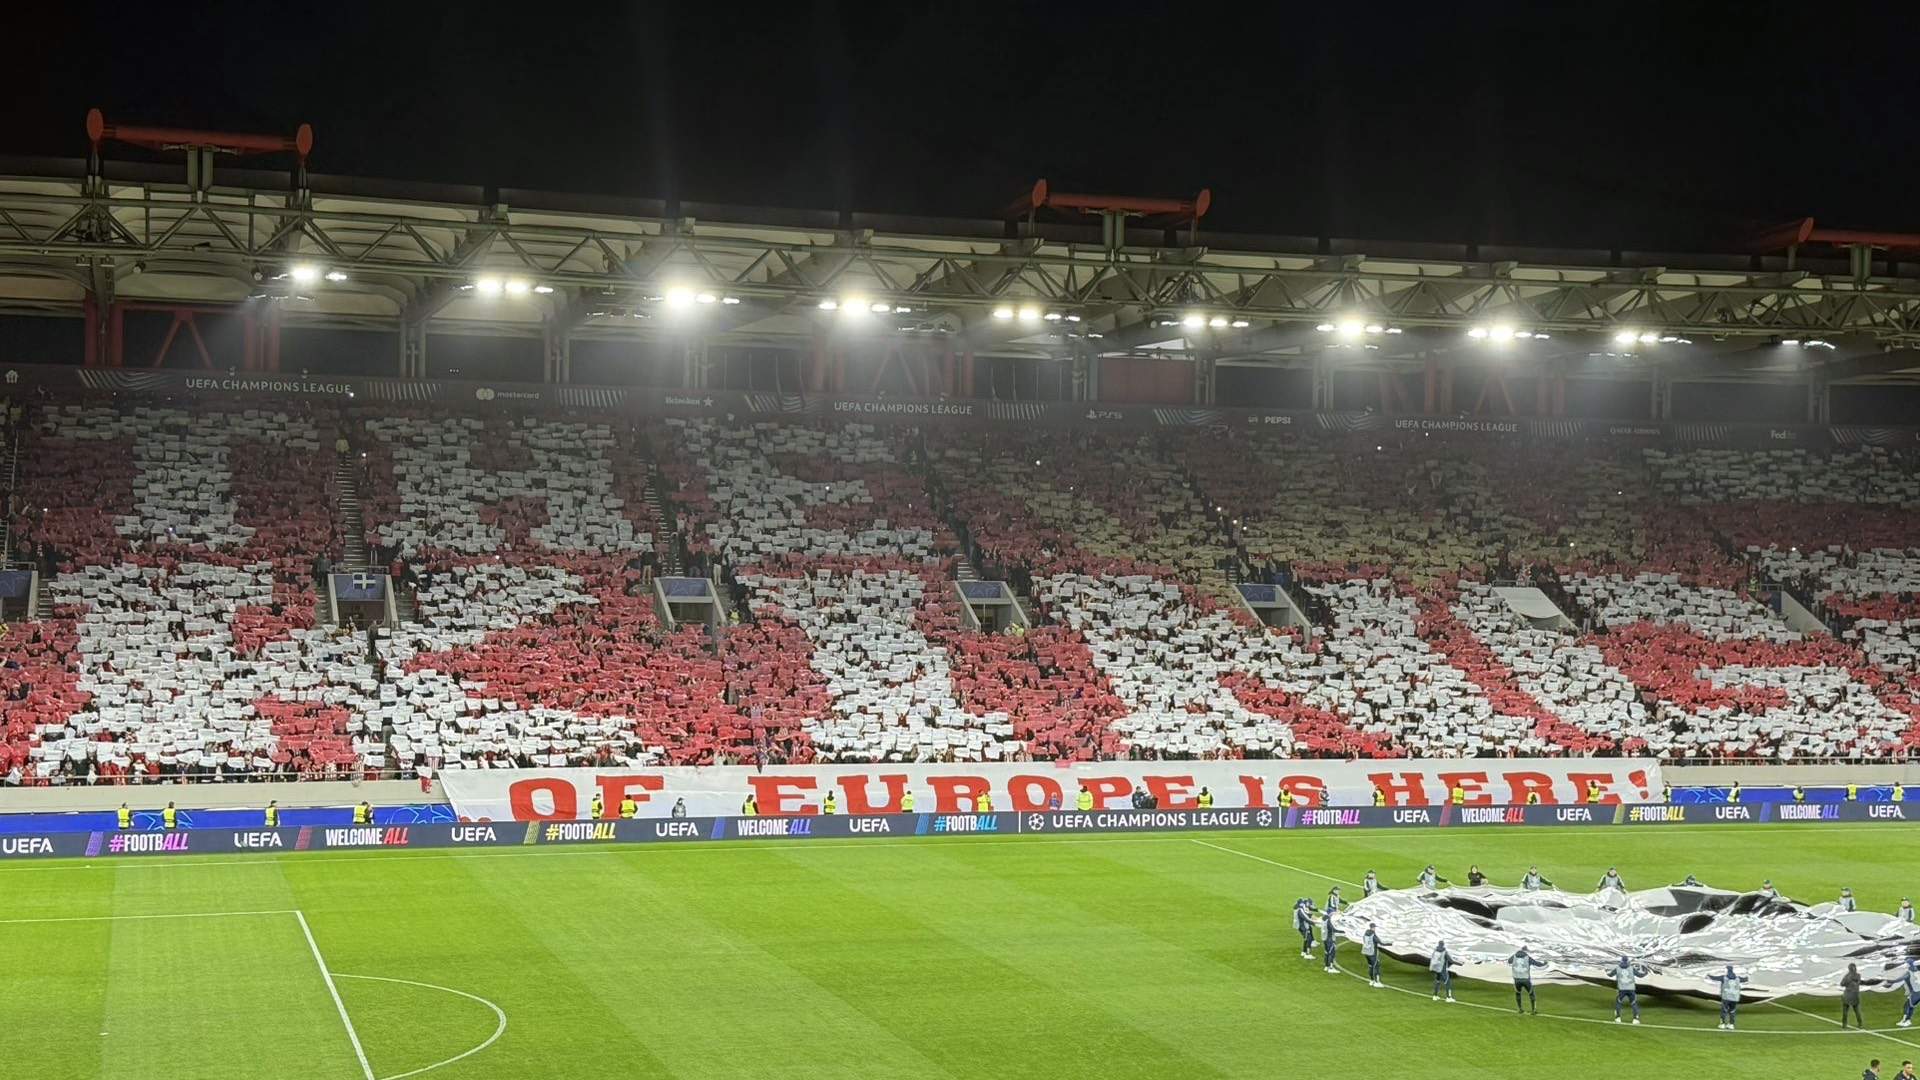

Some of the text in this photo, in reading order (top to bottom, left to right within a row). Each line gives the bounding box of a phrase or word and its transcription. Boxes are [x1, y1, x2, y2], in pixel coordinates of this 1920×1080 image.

[186, 378, 352, 394] UEFA CHAMPIONS LEAGUE
[834, 400, 973, 415] UEFA CHAMPIONS LEAGUE
[1264, 415, 1291, 424] PEPSI
[1395, 419, 1519, 432] UEFA CHAMPIONS LEAGUE
[509, 768, 1650, 823] OF EUROPE IS HERE!
[1301, 808, 1361, 825] #FOOTBALL
[1393, 809, 1430, 824] UEFA
[1461, 807, 1525, 823] WELCOME ALL
[1555, 808, 1593, 821] UEFA
[1629, 806, 1686, 821] #FOOTBALL
[1716, 806, 1750, 819] UEFA
[1780, 804, 1840, 820] WELCOME ALL
[1868, 805, 1903, 818] UEFA
[737, 818, 812, 836] WELCOME ALL
[849, 818, 890, 833] UEFA
[934, 815, 998, 832] #FOOTBALL
[1052, 812, 1249, 828] UEFA CHAMPIONS LEAGUE
[326, 827, 409, 847] WELCOME ALL
[451, 826, 497, 842] UEFA
[545, 822, 617, 841] #FOOTBALL
[655, 822, 699, 837] UEFA
[2, 837, 54, 854] UEFA
[108, 832, 189, 853] #FOOTBALL
[233, 831, 283, 848] UEFA
